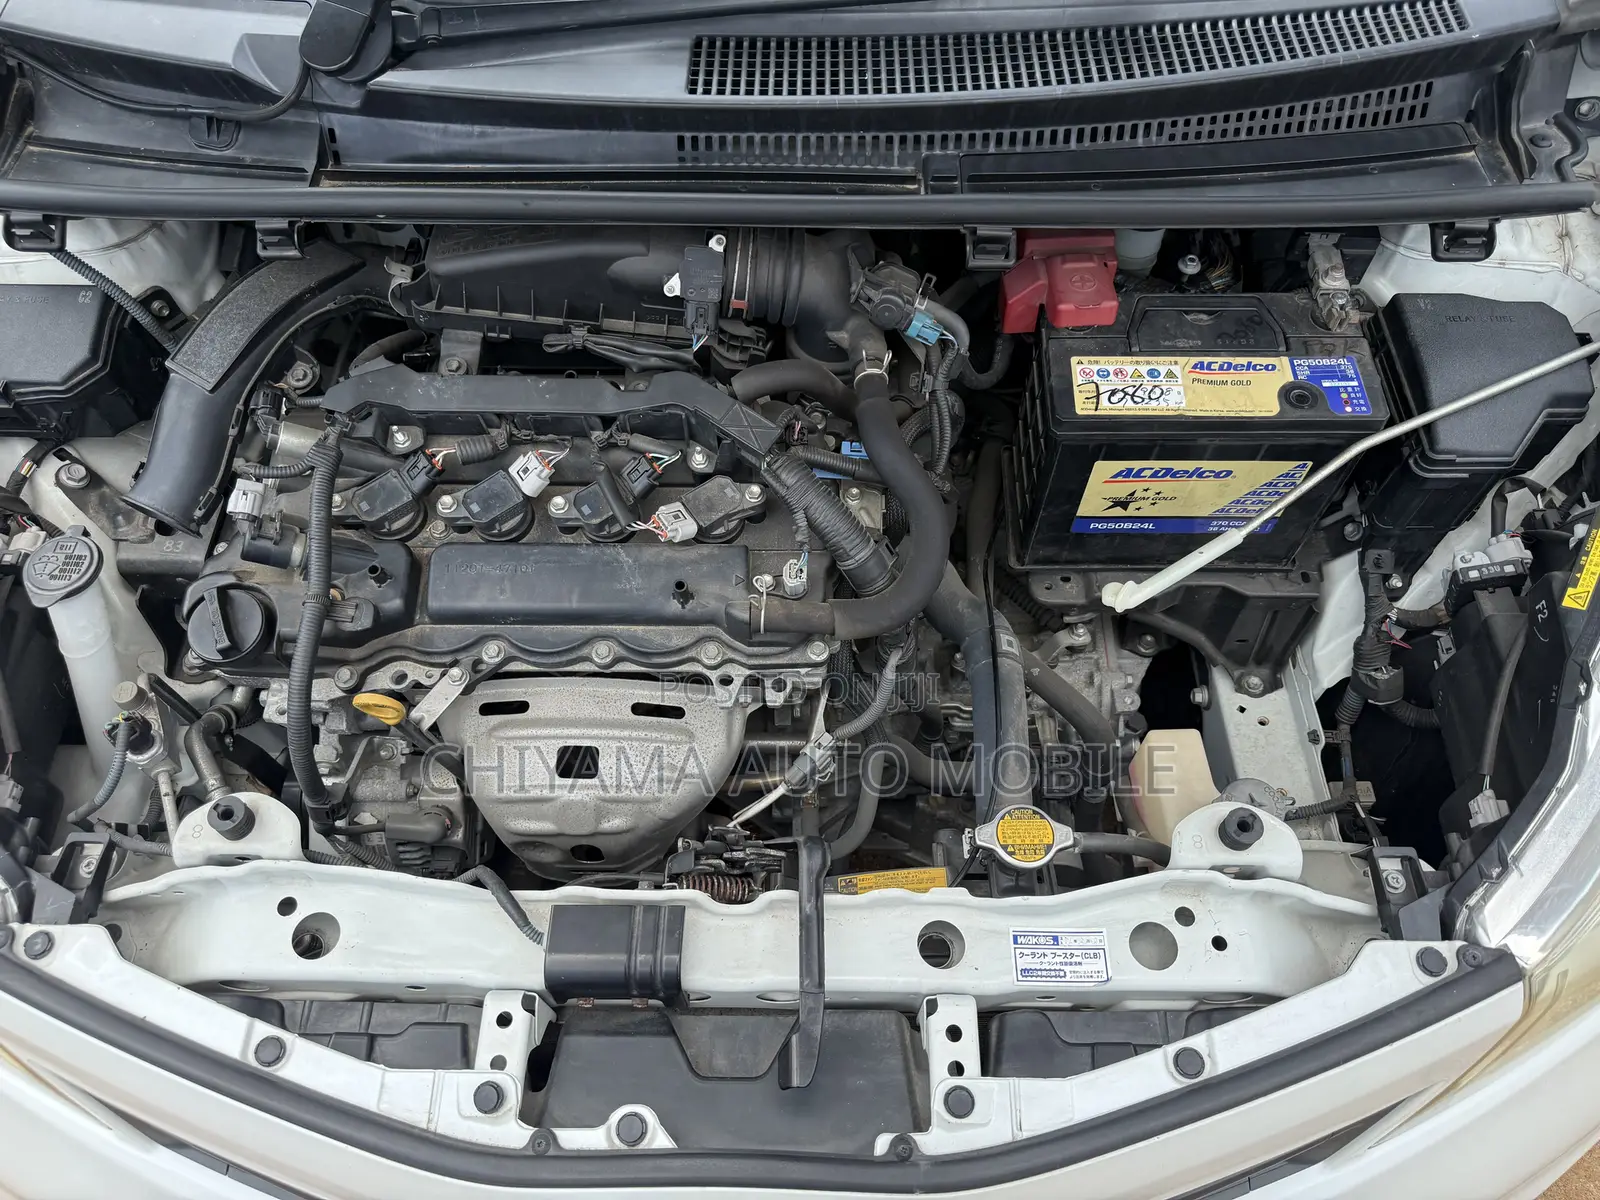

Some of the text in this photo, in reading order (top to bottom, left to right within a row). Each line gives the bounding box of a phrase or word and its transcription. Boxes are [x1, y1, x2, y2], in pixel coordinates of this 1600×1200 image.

[1445, 315, 1476, 323] RELAY
[1191, 360, 1277, 372] ACDelco
[1293, 358, 1351, 366] PG50B24L
[1192, 377, 1252, 387] PREMIUM GOLD
[1109, 466, 1234, 479] ACDelco
[1090, 522, 1156, 530] PG50B24L
[163, 540, 185, 552] 83
[1535, 599, 1549, 623] F2
[192, 824, 204, 839] 8
[1018, 951, 1048, 959] クーラント
